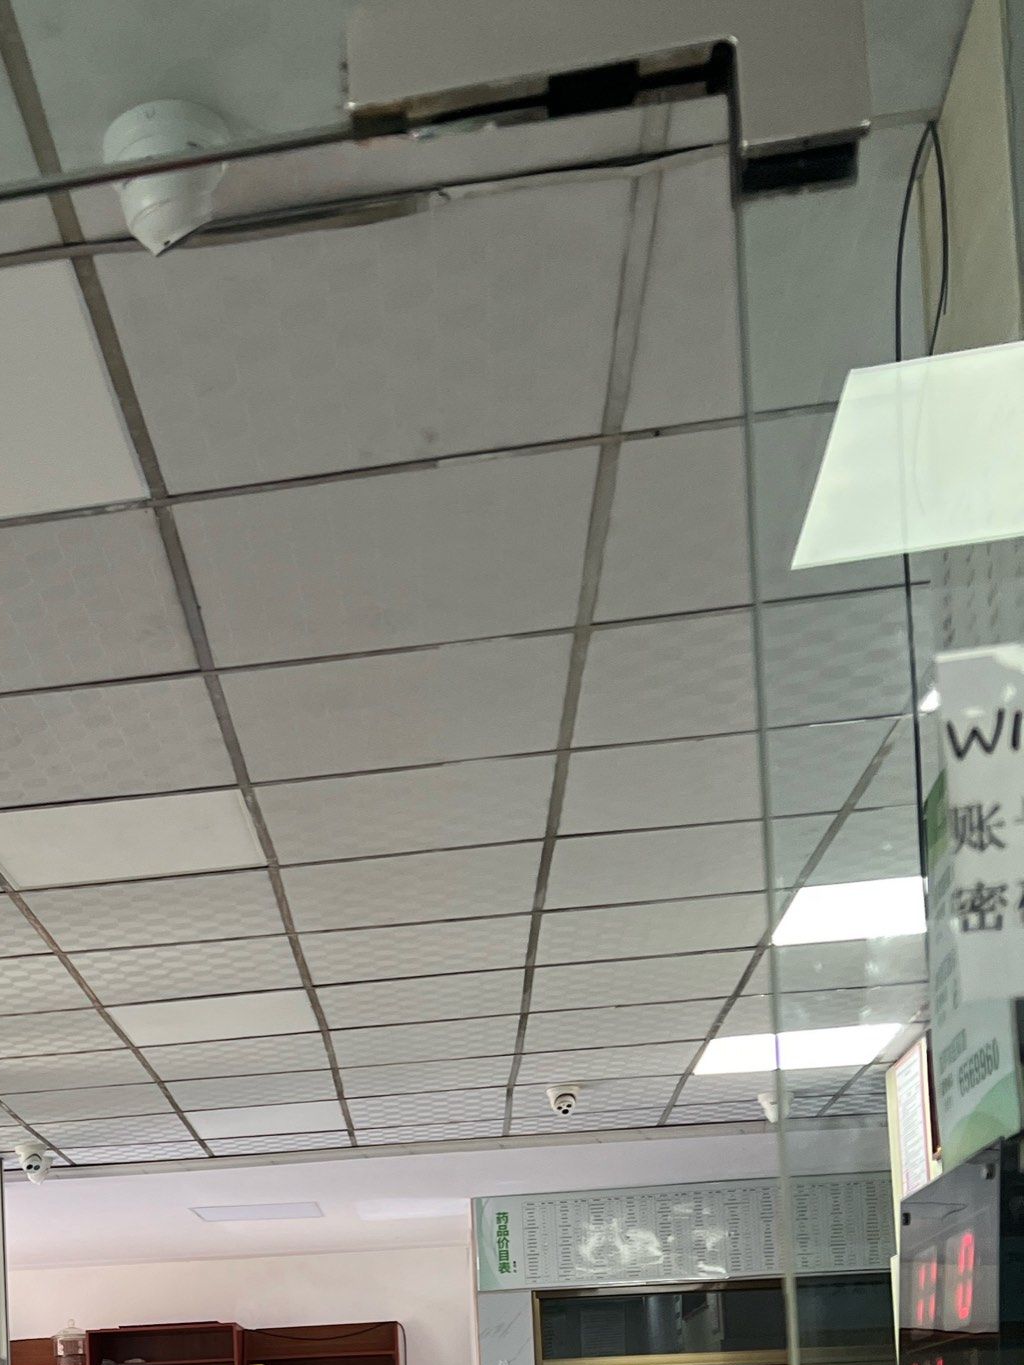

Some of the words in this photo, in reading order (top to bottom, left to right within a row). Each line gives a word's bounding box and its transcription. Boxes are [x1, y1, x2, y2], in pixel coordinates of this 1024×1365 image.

[951, 800, 1024, 855] 账
[954, 880, 1024, 933] 密
[495, 1211, 512, 1275] 药品价目表
